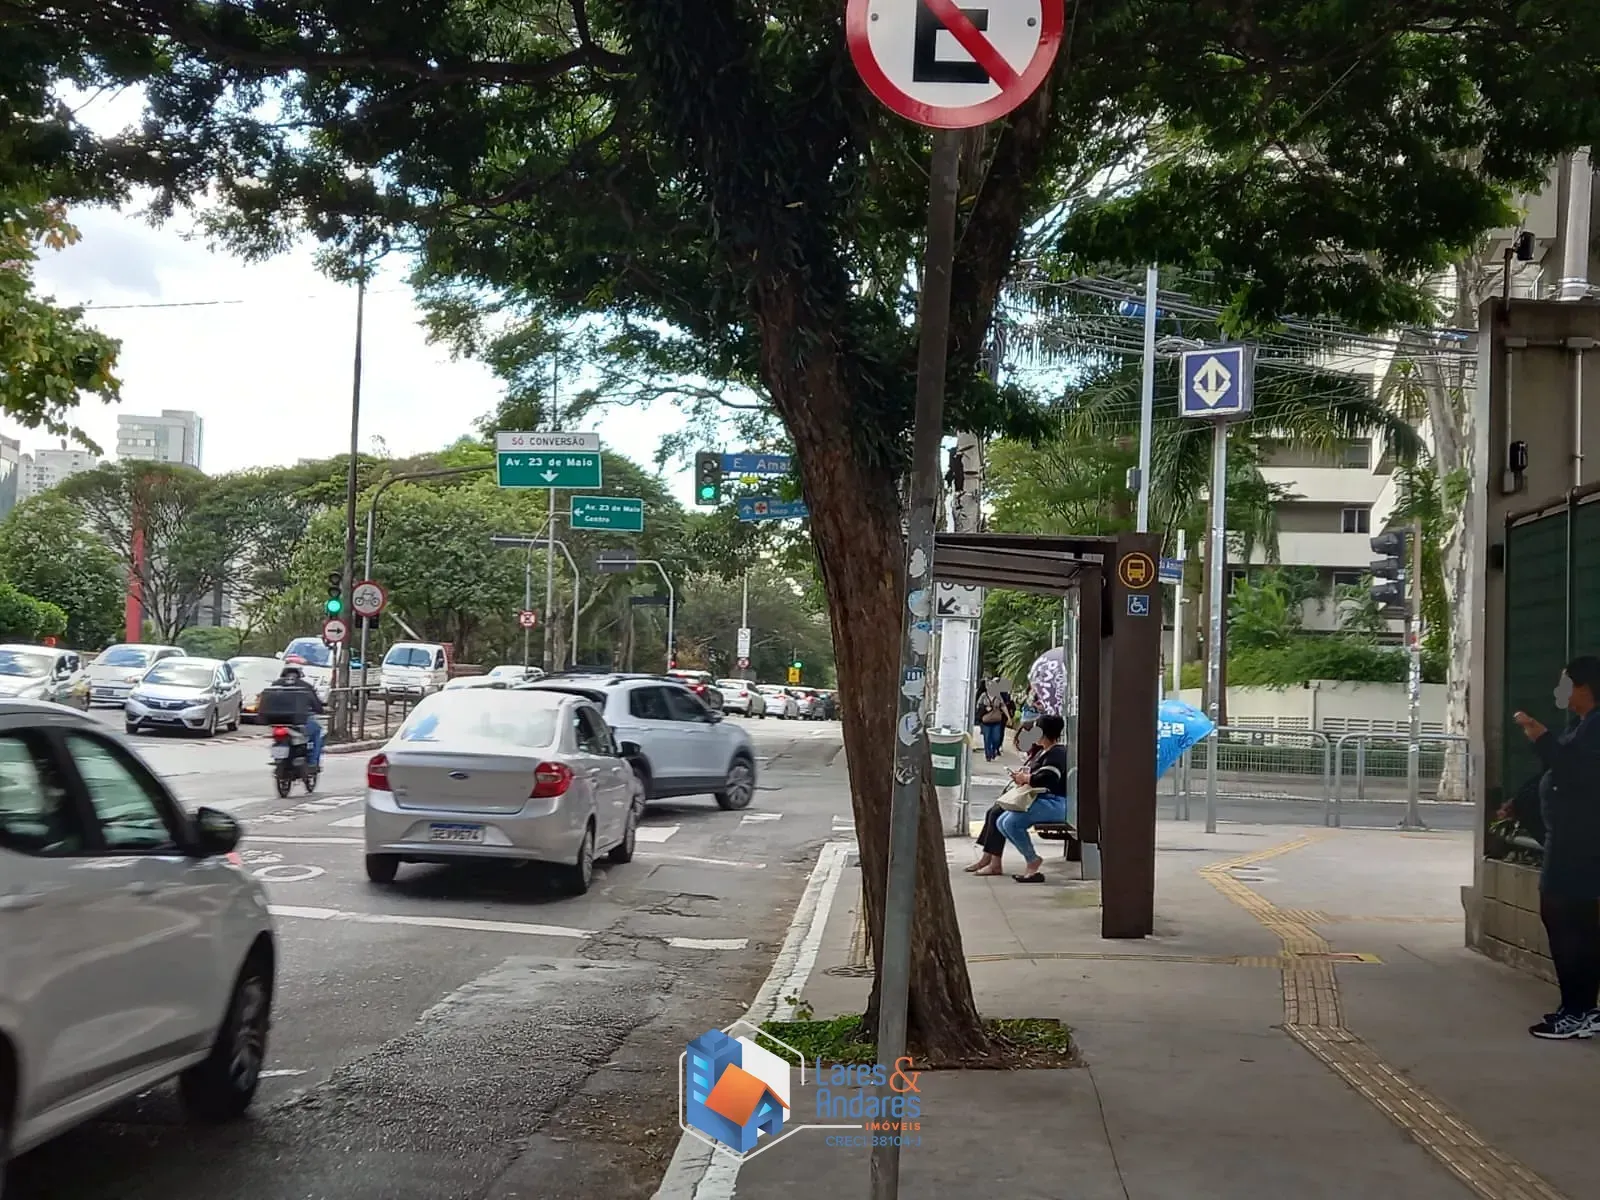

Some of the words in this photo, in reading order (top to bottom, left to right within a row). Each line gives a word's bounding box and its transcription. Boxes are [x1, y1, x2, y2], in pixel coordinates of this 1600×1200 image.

[511, 436, 524, 446] SÓ
[529, 436, 585, 446] CONVERSÃO
[505, 457, 523, 467] Av.
[528, 457, 543, 467] 23
[548, 458, 562, 467] de
[566, 458, 593, 467] Maio
[611, 504, 621, 512] de
[623, 505, 641, 513] Maio
